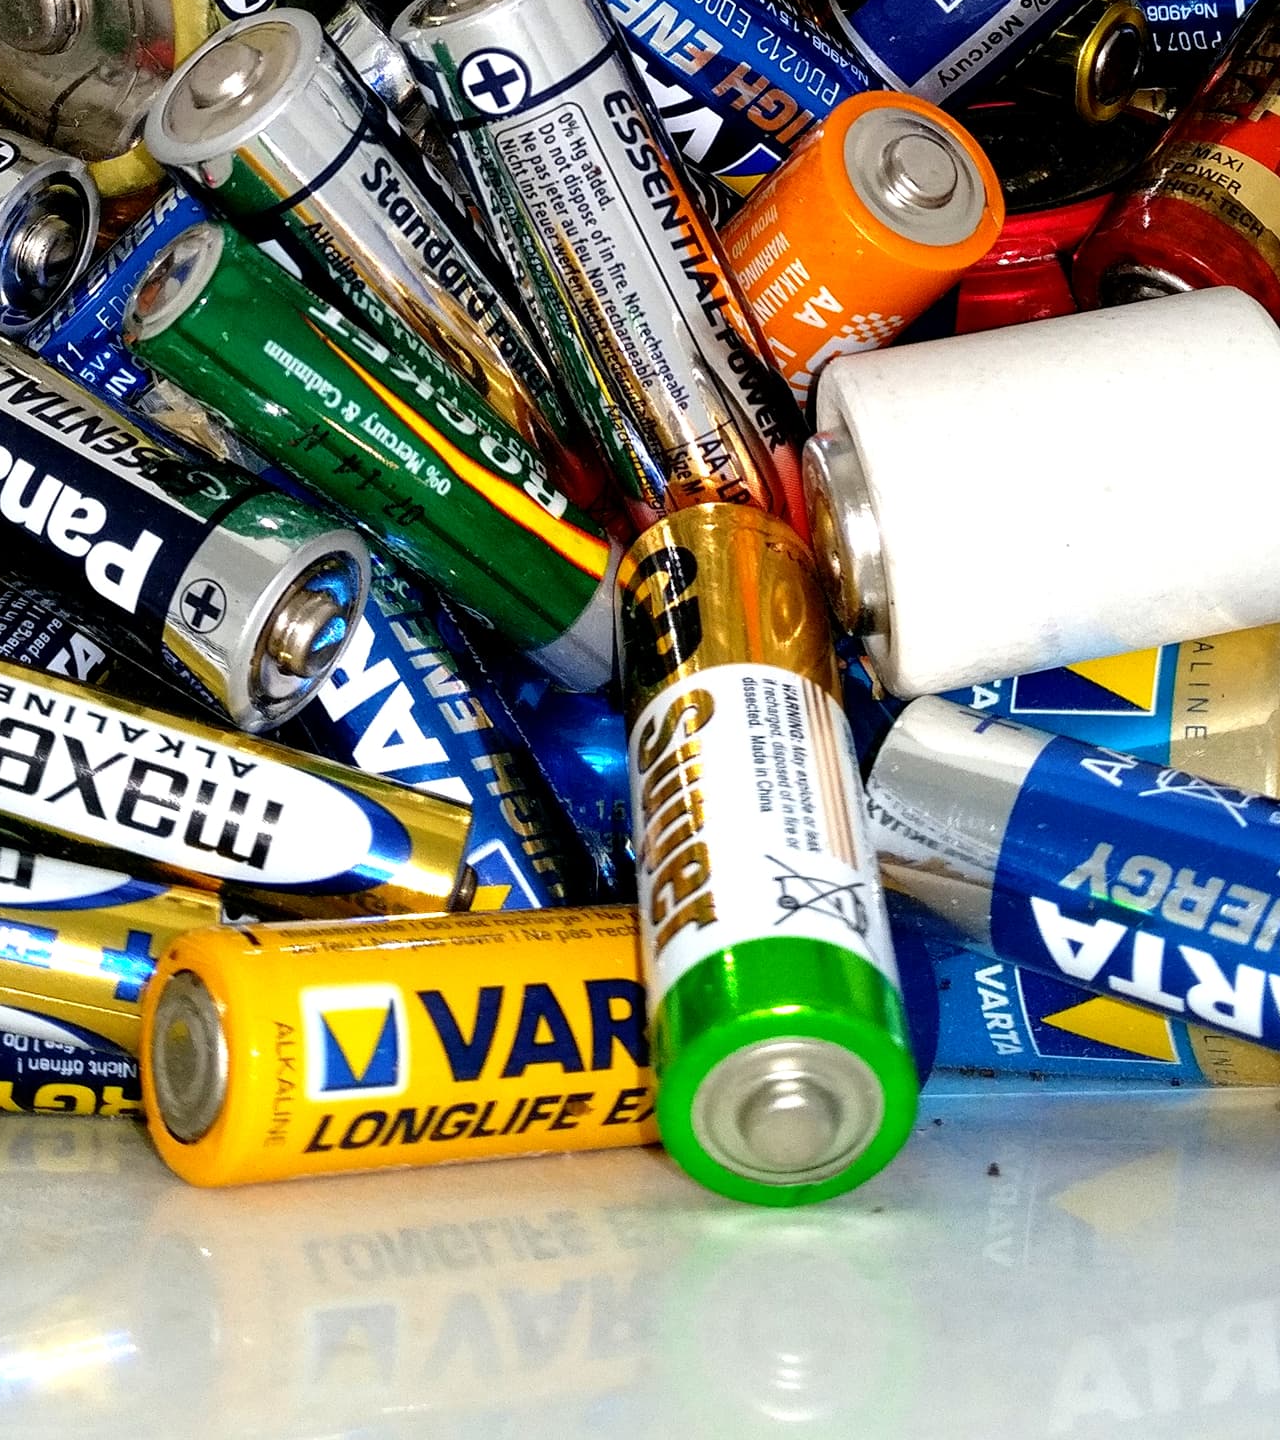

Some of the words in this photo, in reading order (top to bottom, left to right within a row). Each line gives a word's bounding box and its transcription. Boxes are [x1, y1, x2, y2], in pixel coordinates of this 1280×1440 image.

[756, 27, 841, 107] PD0212
[935, 12, 1027, 90] Mercury
[1171, 161, 1243, 196] POWER
[1192, 142, 1246, 173] MAXI
[562, 172, 597, 228] dispose
[603, 89, 725, 327] ESSENTIAL
[358, 157, 501, 324] Standard
[792, 285, 845, 329] AA
[261, 340, 347, 405] Cadmium
[356, 407, 437, 486] Mercury
[416, 978, 650, 1083] VAR
[972, 962, 1024, 1057] VARTA
[303, 1092, 595, 1154] LONGLIFE
